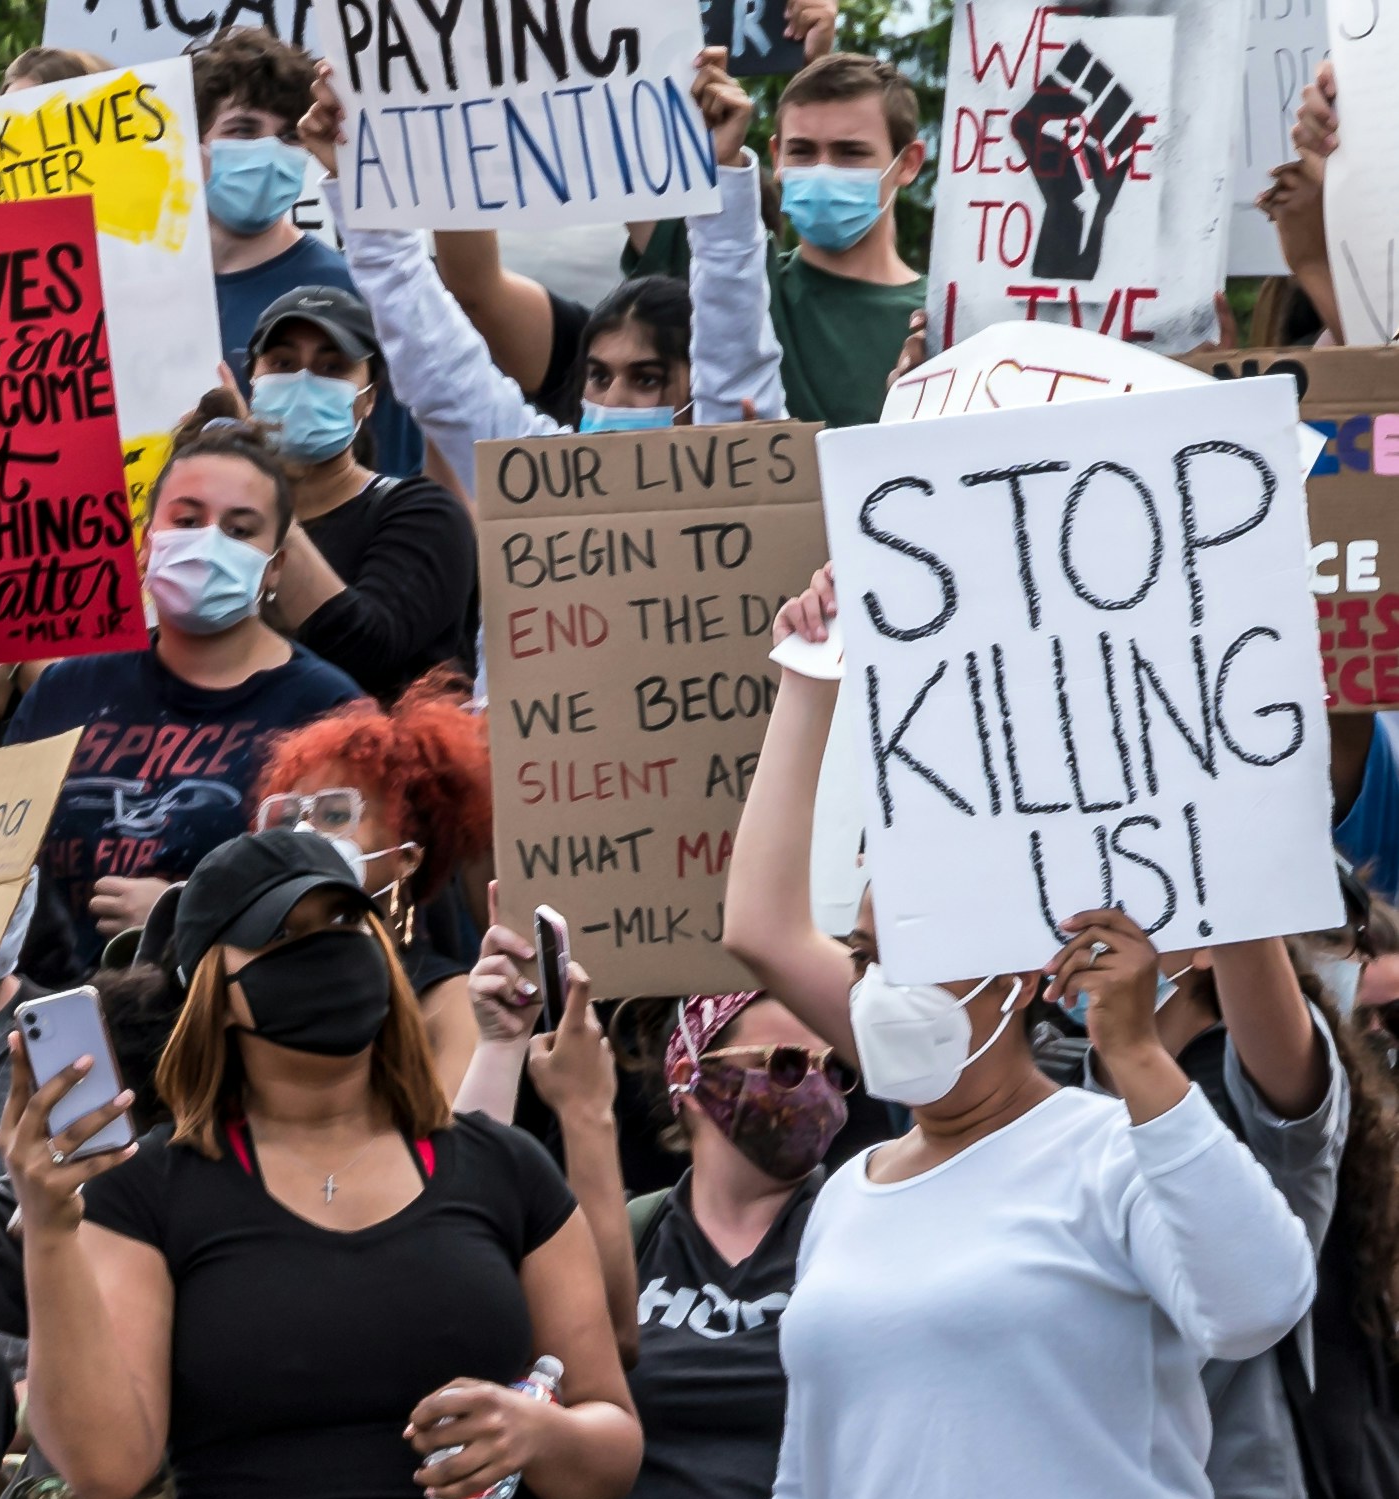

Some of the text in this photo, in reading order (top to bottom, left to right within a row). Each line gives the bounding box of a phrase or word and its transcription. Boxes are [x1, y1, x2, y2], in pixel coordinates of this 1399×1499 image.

[341, 0, 640, 94] PAYING
[965, 2, 1080, 94] WE
[36, 84, 166, 152] LIVES
[354, 76, 717, 213] ATTENTION
[952, 106, 1157, 182] DESERVE
[968, 201, 1032, 267] TO
[498, 433, 796, 504] OUR LIVES
[502, 521, 751, 588] BEGIN TO
[858, 439, 1279, 643] STOP
[508, 593, 729, 660] END THE
[511, 690, 598, 739] WE
[866, 625, 1304, 826] KILLING
[72, 721, 258, 779] SPACE
[518, 757, 678, 805] SILENT
[516, 826, 655, 880] WHAT
